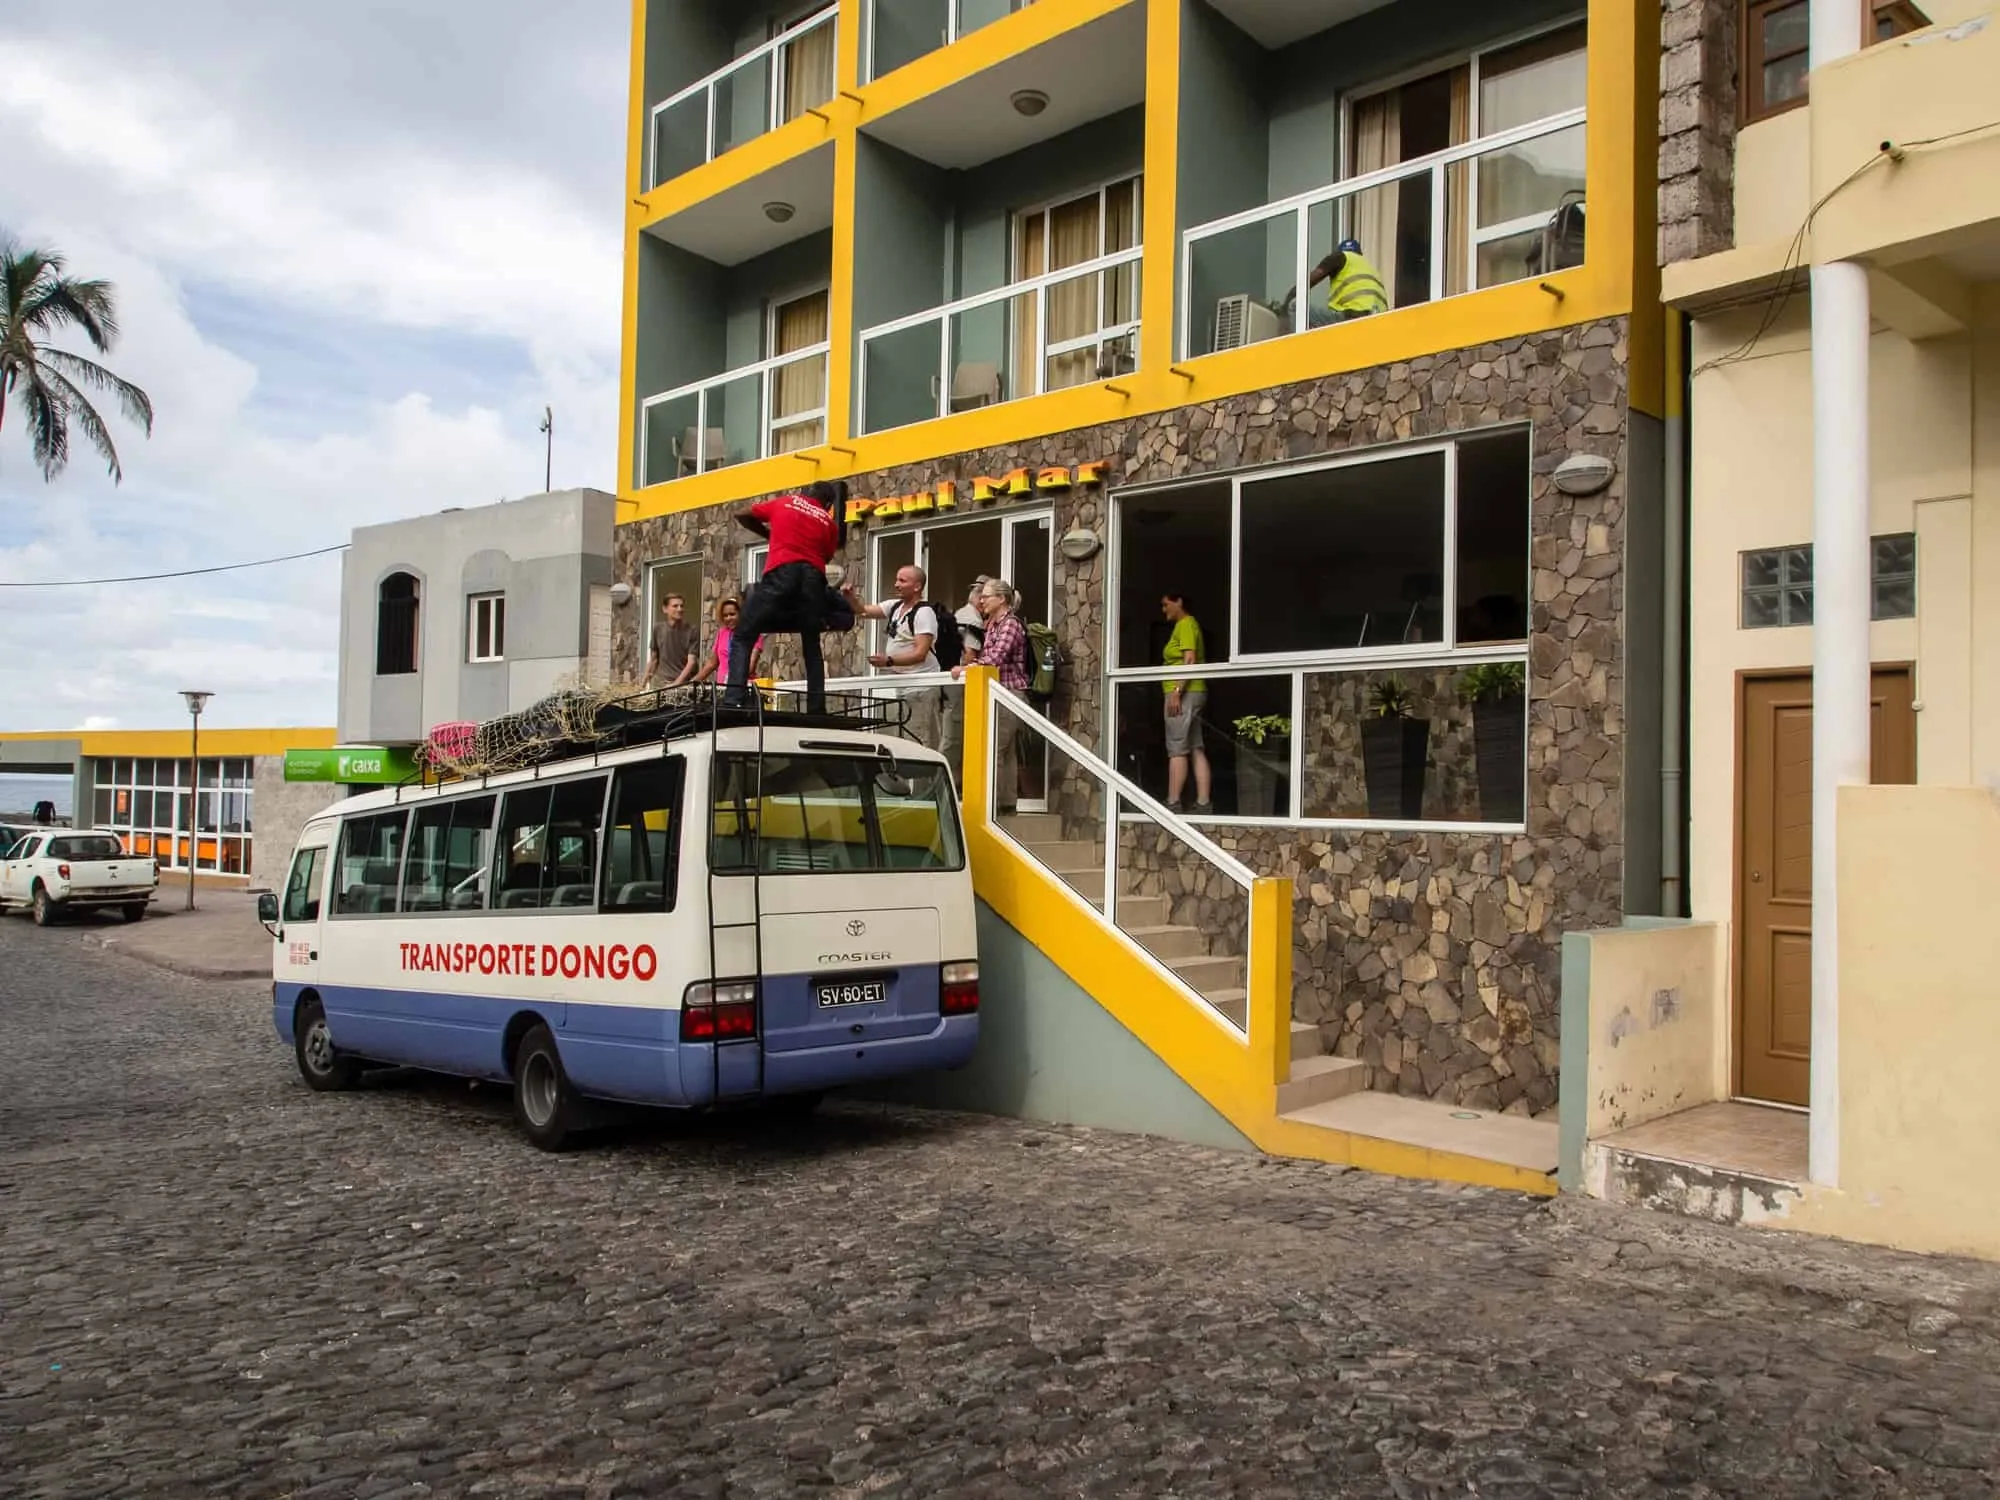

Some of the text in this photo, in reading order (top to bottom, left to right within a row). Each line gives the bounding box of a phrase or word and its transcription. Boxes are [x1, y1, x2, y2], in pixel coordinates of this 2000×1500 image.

[844, 480, 957, 523] Paul
[971, 460, 1110, 501] Mar
[351, 759, 381, 774] caixa
[399, 943, 658, 982] TRANSPORTE DONGO
[817, 951, 892, 965] COASTER
